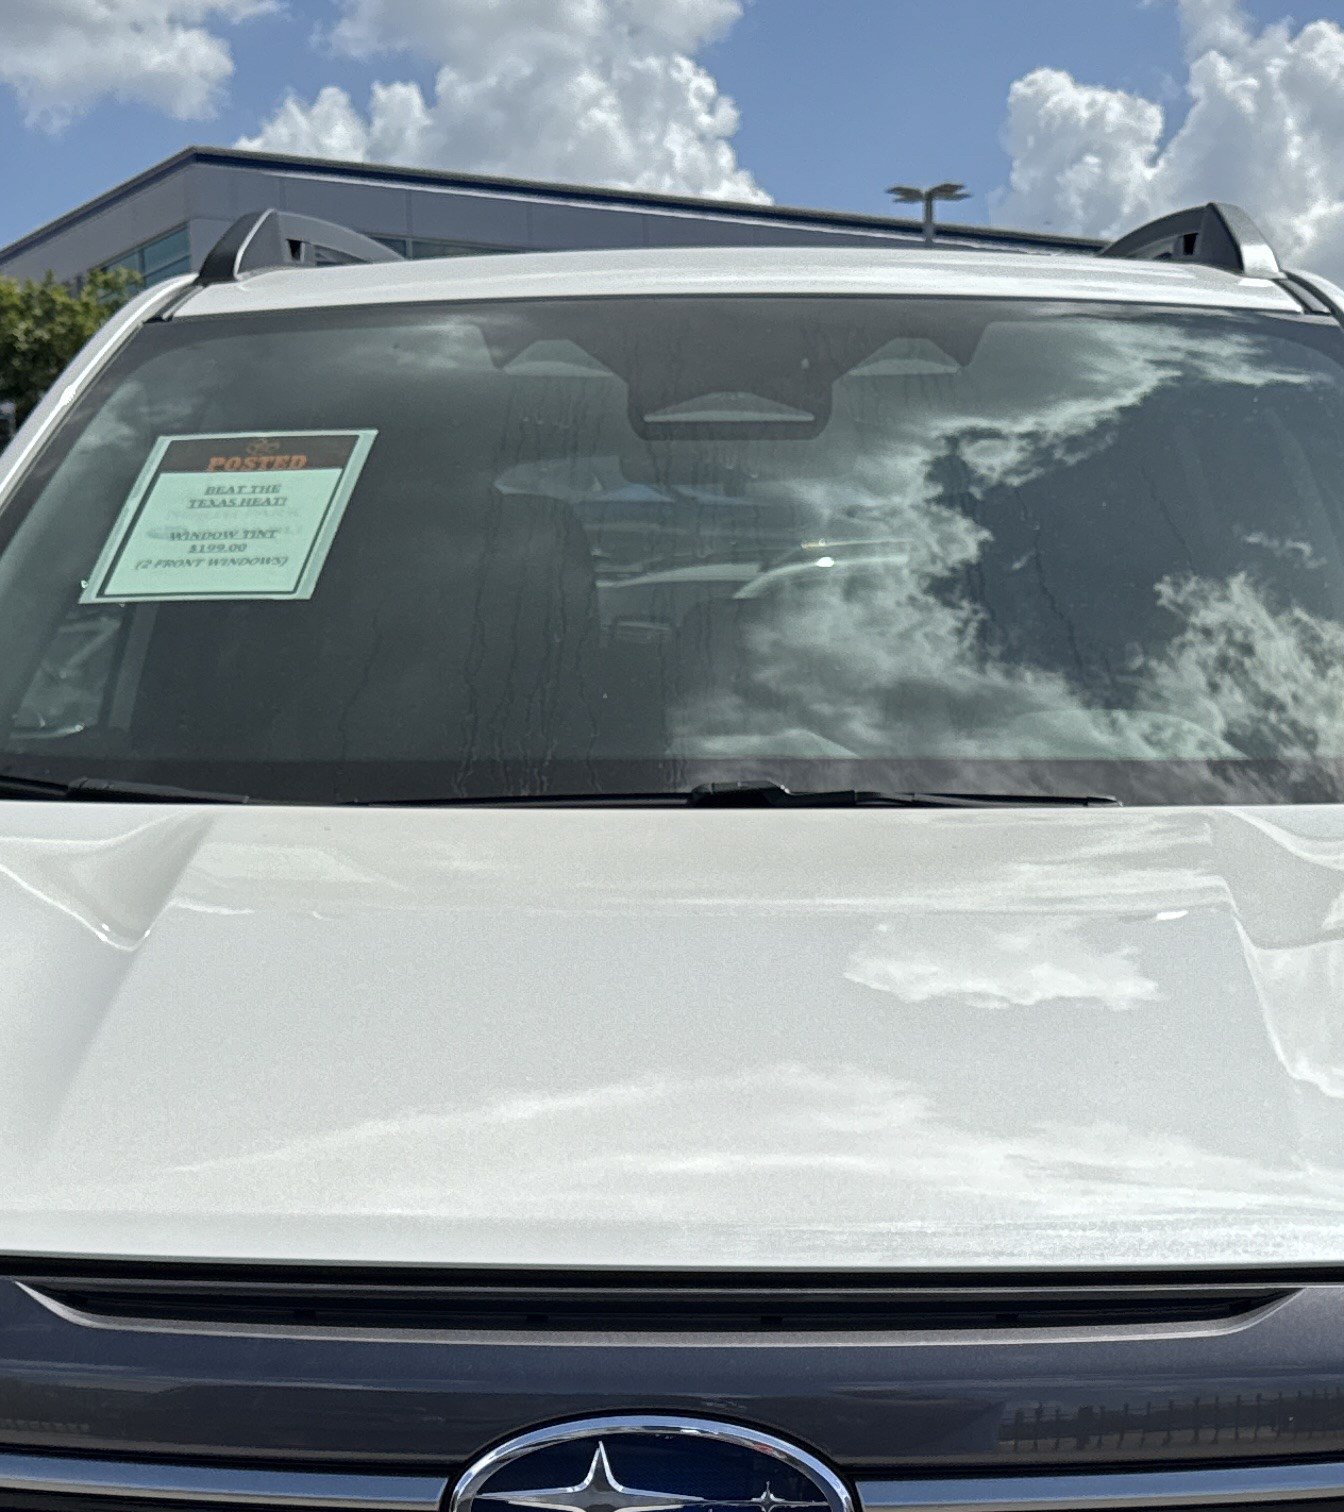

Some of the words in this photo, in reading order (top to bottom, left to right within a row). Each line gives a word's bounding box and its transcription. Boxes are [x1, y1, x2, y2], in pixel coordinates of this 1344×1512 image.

[206, 455, 308, 472] POSTED
[204, 485, 248, 496] BEAT
[250, 483, 283, 494] THE
[188, 498, 237, 509] TEXAS
[237, 496, 288, 507] HEAT!
[169, 529, 239, 541] WINDOW
[242, 528, 279, 539] TINT
[188, 543, 248, 554] $199.00
[154, 557, 206, 569] FRONT
[207, 554, 289, 568] WINDOWS)
